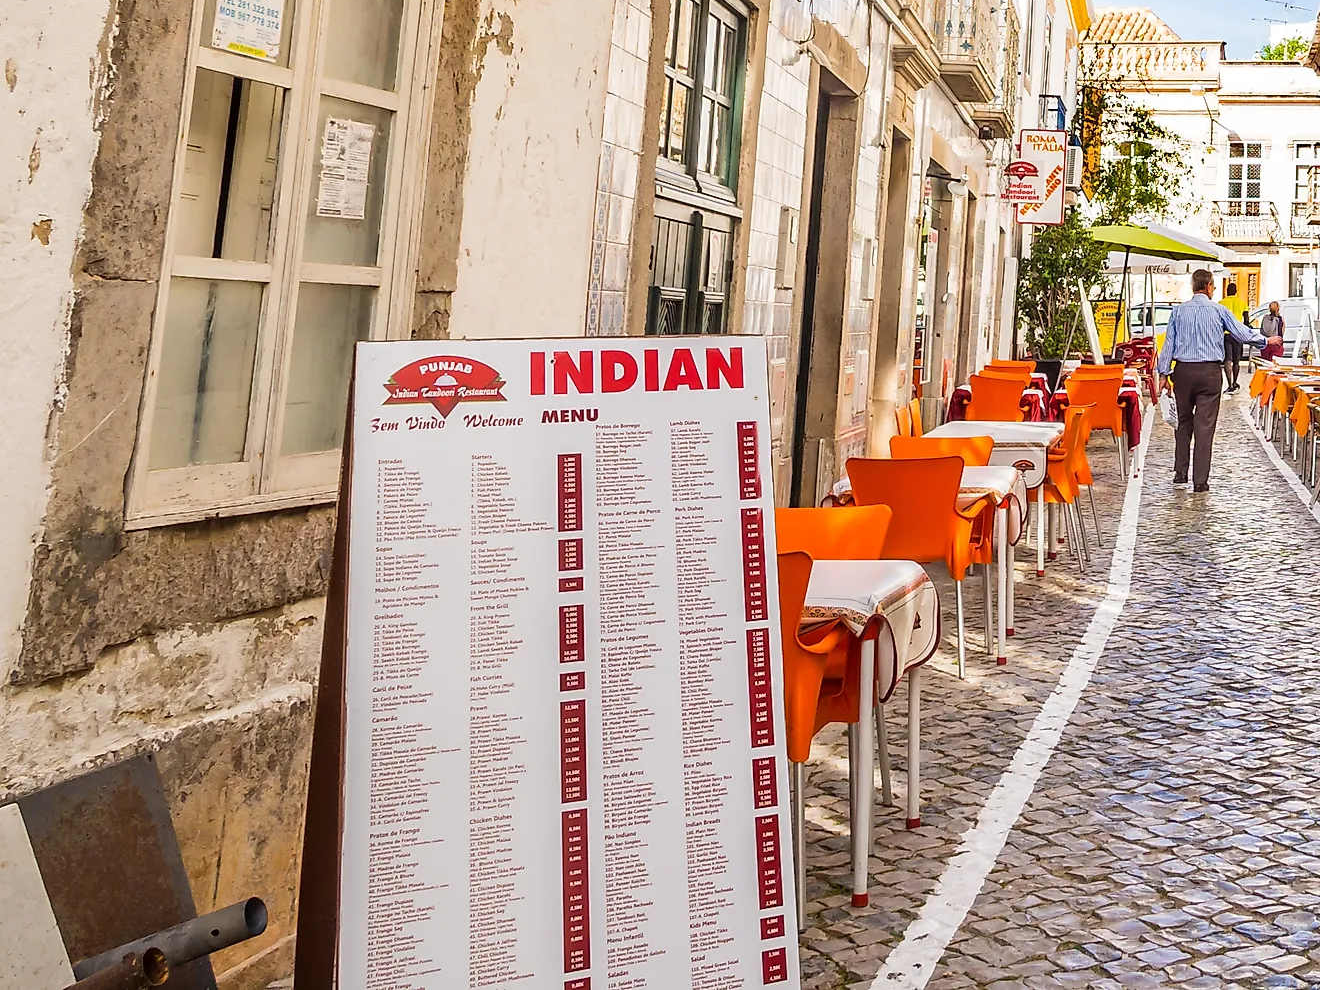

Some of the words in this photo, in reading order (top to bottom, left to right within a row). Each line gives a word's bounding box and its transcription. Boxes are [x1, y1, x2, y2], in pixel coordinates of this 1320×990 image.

[219, 6, 236, 18] MOB
[1027, 135, 1056, 143] ROMA
[419, 361, 473, 375] PUNJAB
[529, 347, 745, 396] INDIAN
[392, 388, 418, 399] Indian
[421, 387, 455, 398] Tandoori
[457, 386, 498, 398] Restaurant
[406, 415, 446, 431] Vindo
[463, 413, 524, 428] Welcome
[541, 408, 599, 424] MENU
